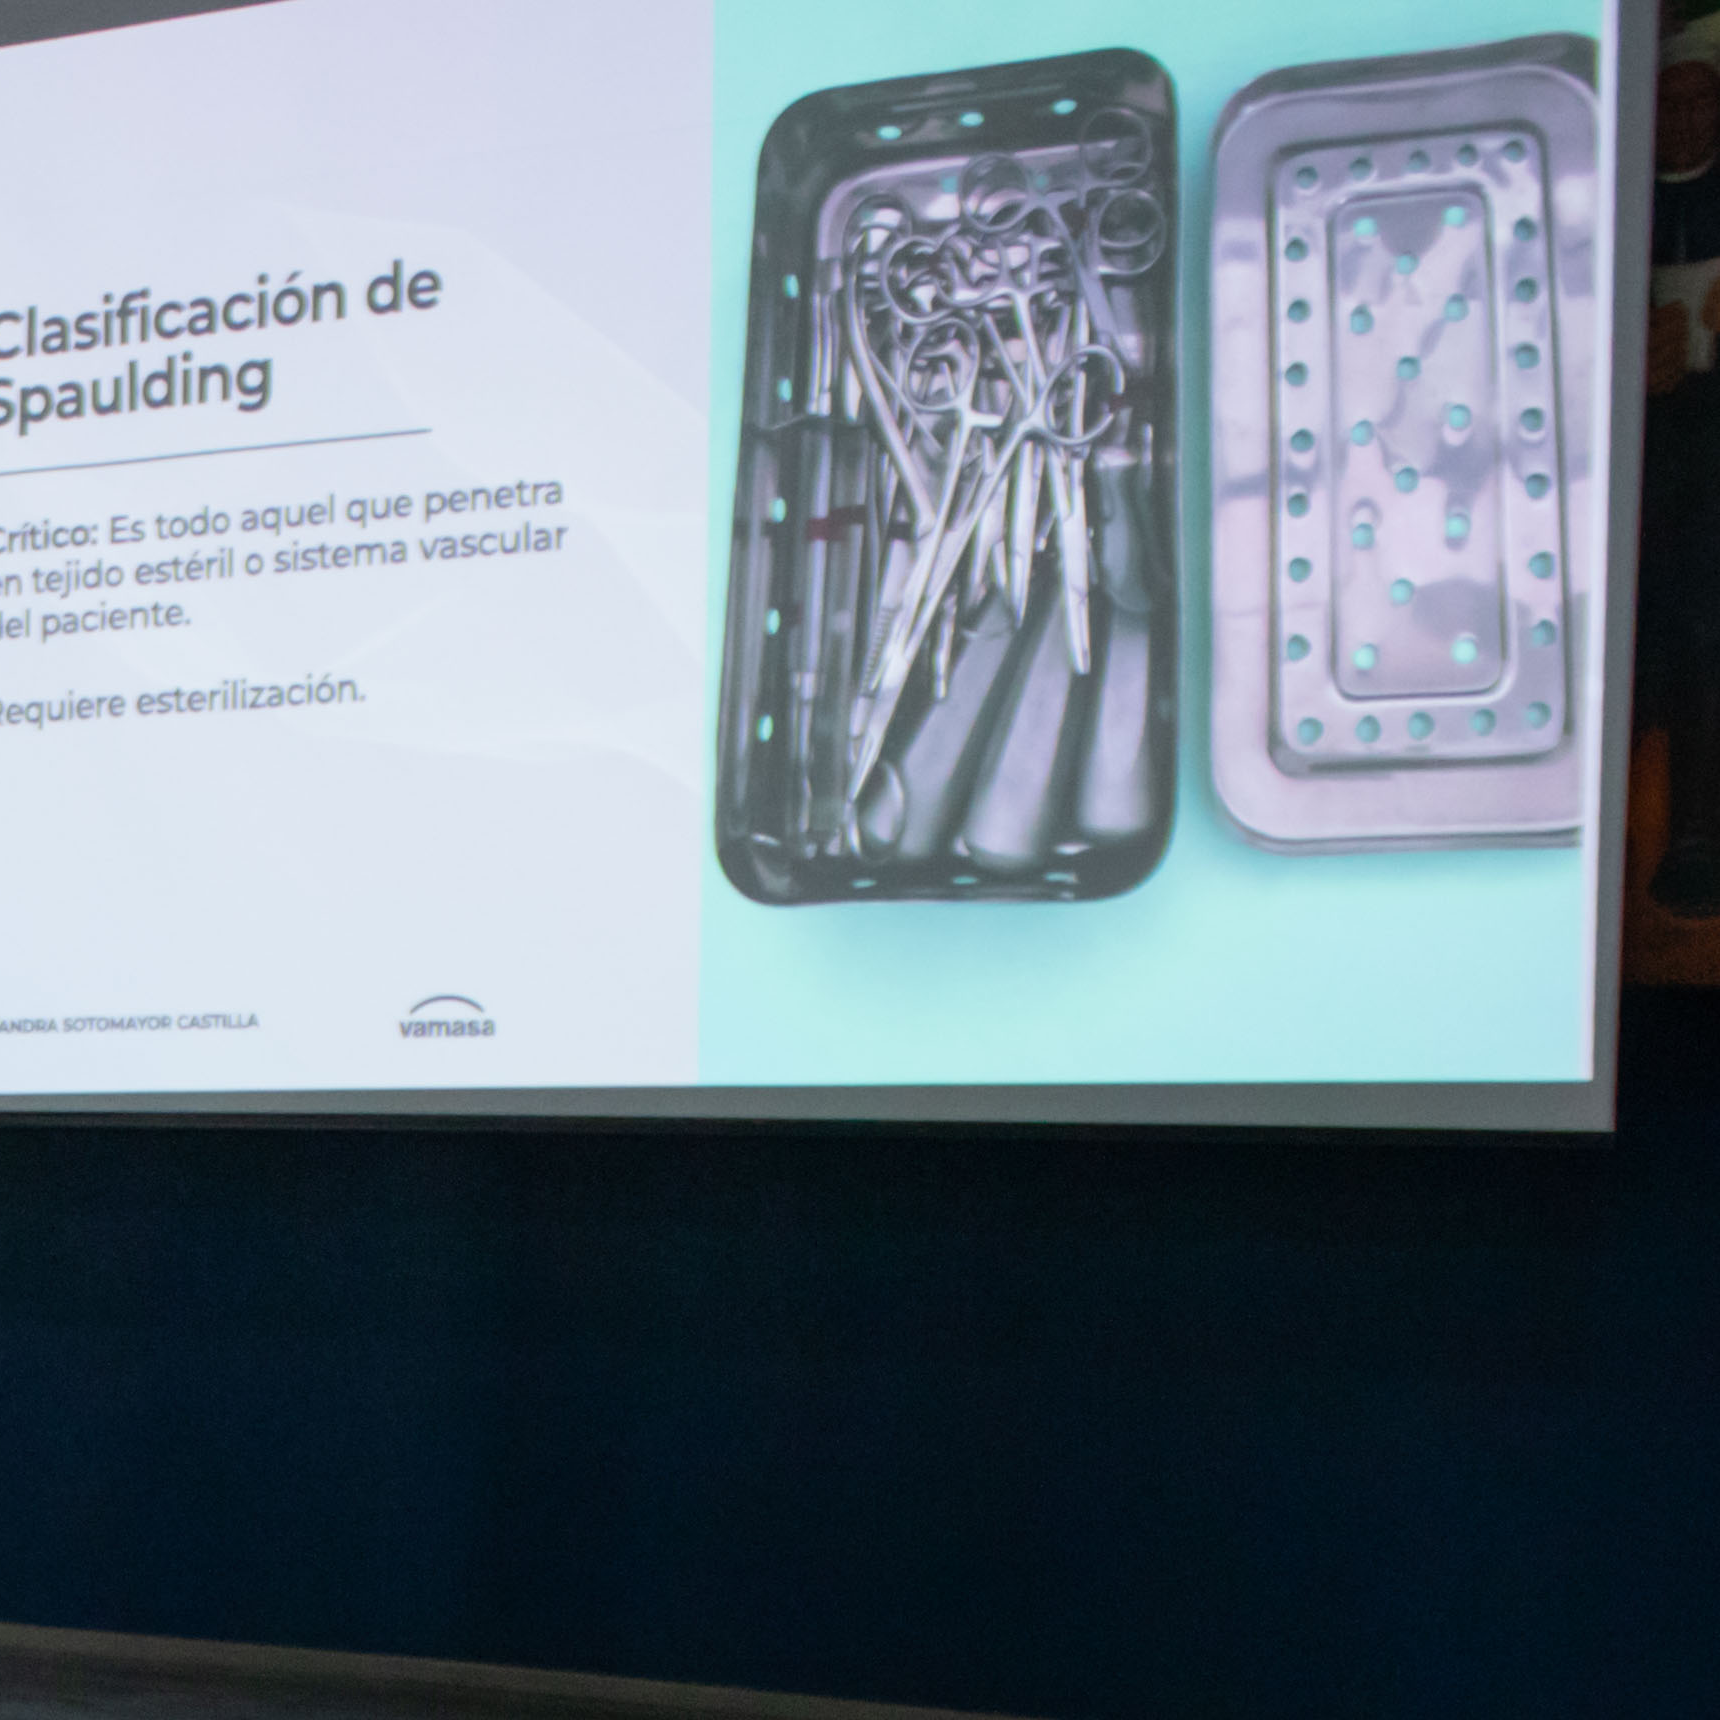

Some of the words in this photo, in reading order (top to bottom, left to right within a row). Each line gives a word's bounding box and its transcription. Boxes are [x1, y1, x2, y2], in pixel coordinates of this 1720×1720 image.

[365, 258, 444, 315] de
[109, 516, 146, 545] Es
[155, 504, 231, 541] todo
[241, 493, 336, 537] aquel
[345, 494, 413, 528] que
[423, 478, 563, 522] penetra
[32, 560, 124, 600] tejido
[134, 547, 235, 586] estéril
[245, 553, 263, 576] o
[273, 535, 408, 573] sistema
[418, 521, 567, 561] vascular
[41, 598, 191, 644] paciente.
[136, 673, 366, 715] esterilización.
[62, 1015, 172, 1033] SOTOMAYOR
[176, 1013, 261, 1030] CASTILLA
[399, 1018, 496, 1038] vamasa
